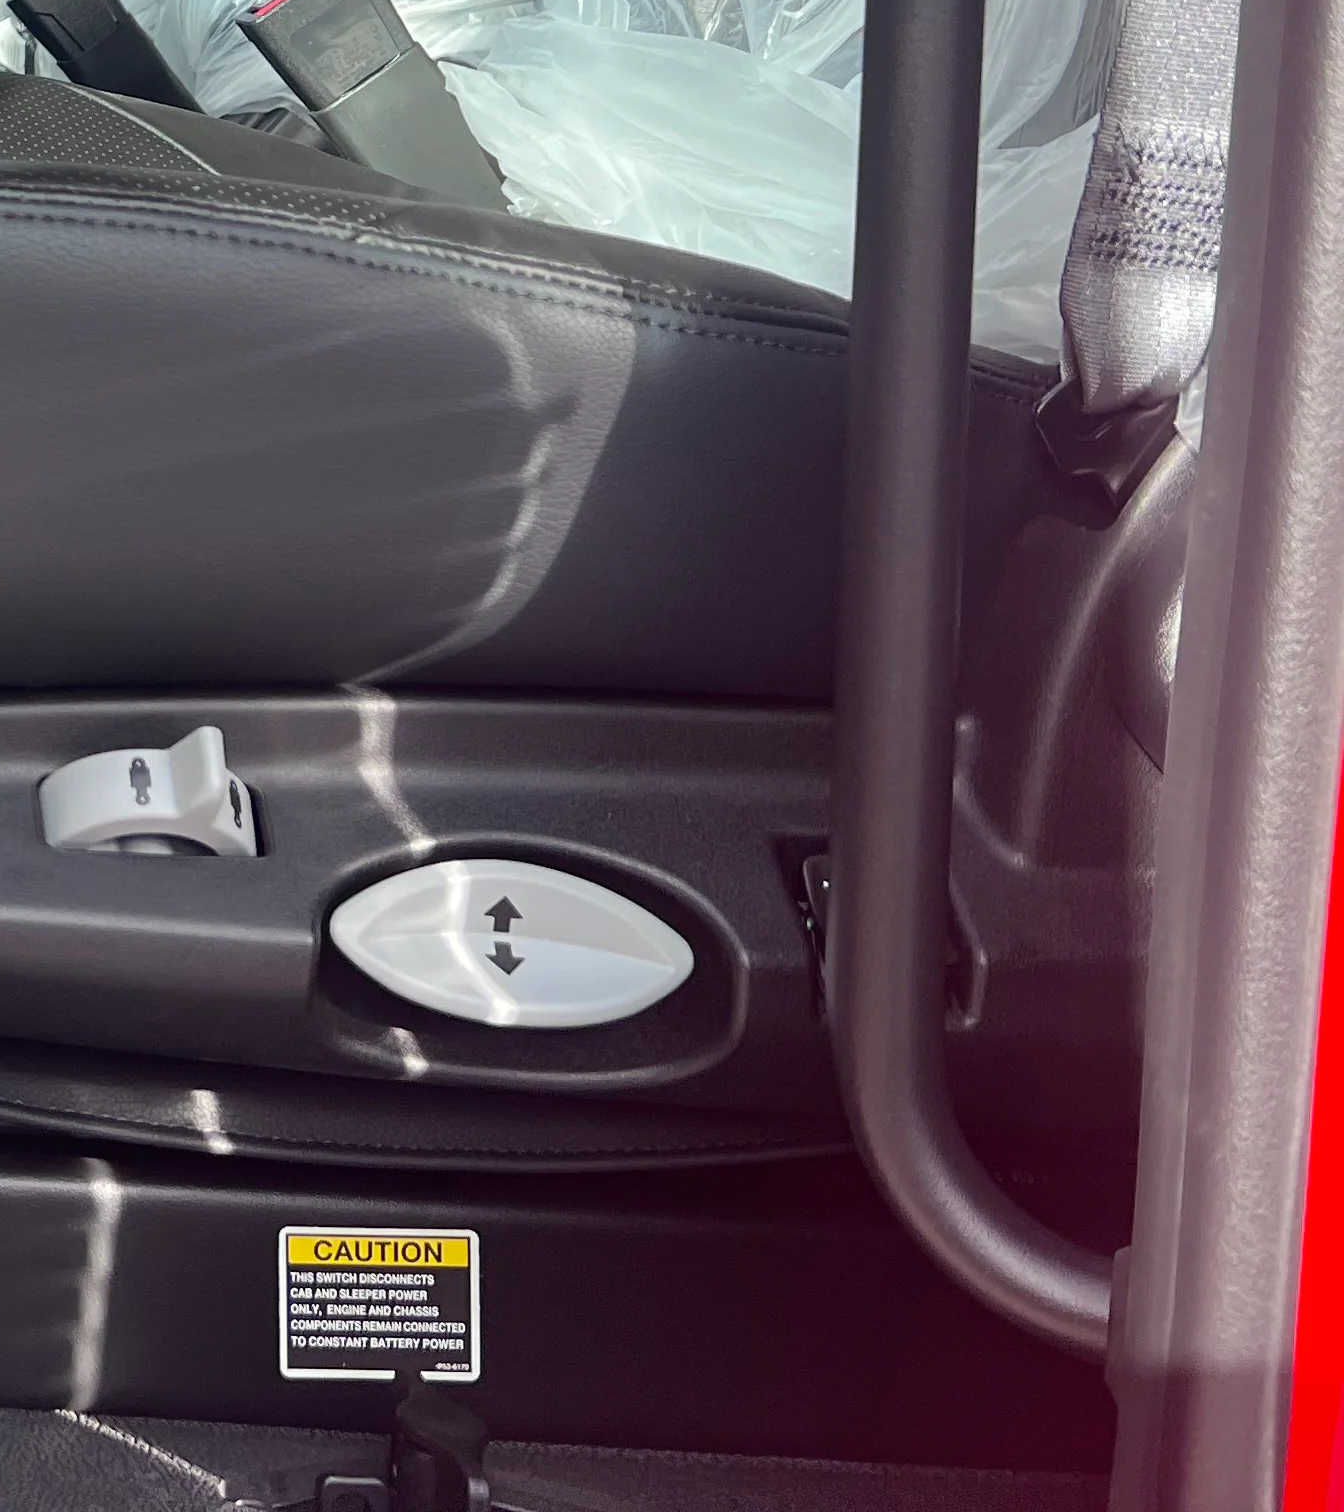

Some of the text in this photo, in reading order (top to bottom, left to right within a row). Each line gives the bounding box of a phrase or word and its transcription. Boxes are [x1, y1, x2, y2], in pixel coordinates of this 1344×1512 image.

[313, 1239, 443, 1263] CAUTION
[290, 1271, 435, 1285] THIS SWITCH DISCONNECTS
[289, 1287, 428, 1301] CAB AND SLEEPER POWER
[290, 1303, 439, 1317] ONLY, ENGINE AND CHASSIS
[290, 1319, 466, 1334] COMPONENTS REMAIN CONNECTED
[290, 1335, 464, 1350] TO CONSTANT BATTERY POWER
